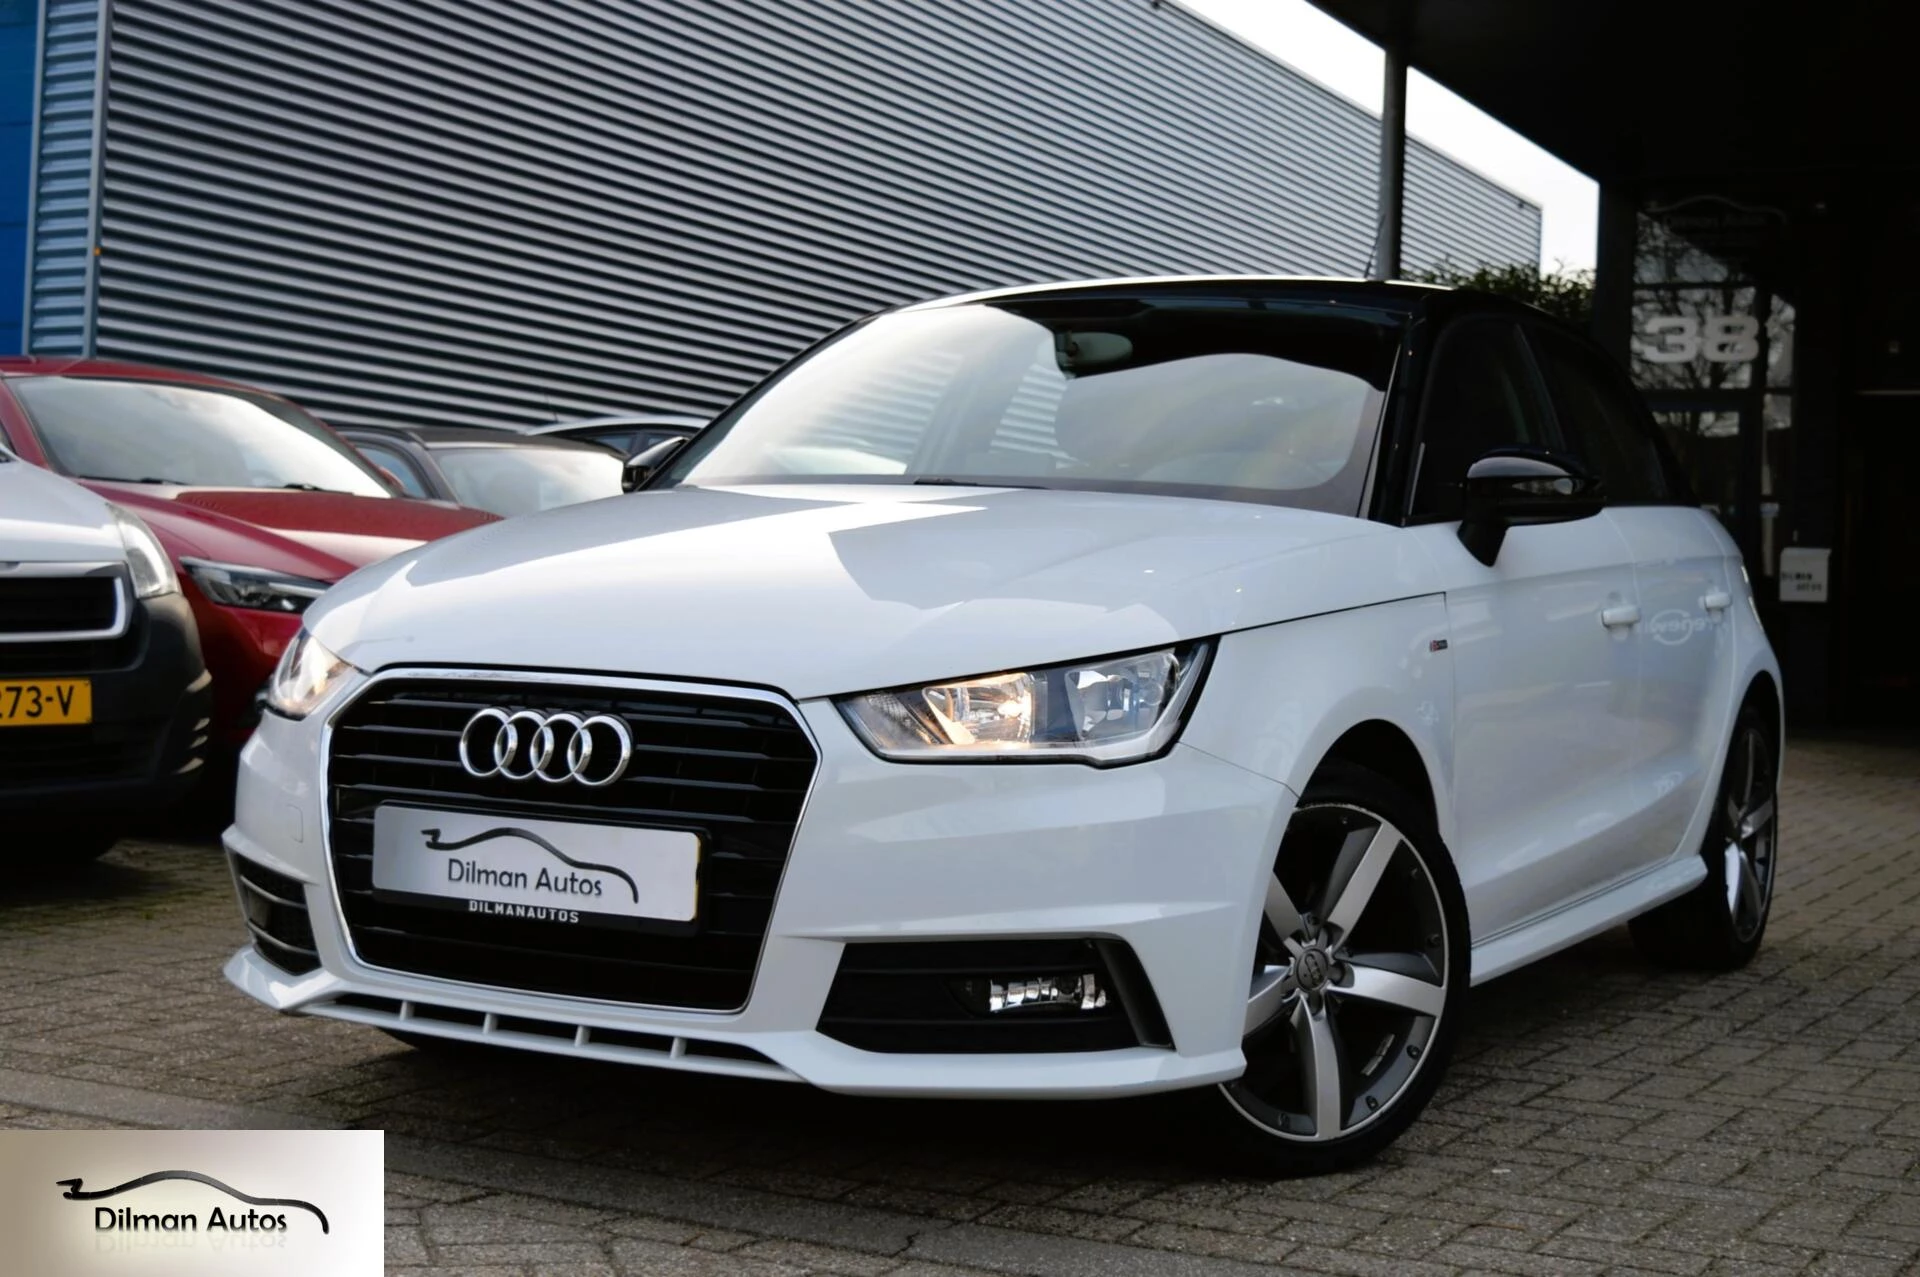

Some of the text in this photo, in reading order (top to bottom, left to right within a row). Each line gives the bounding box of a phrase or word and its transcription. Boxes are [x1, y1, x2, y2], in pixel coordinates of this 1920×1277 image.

[1643, 316, 1760, 363] 38
[0, 685, 75, 719] 73-V
[448, 858, 602, 896] Dilman Autos
[469, 900, 579, 923] DILMANAUTOS
